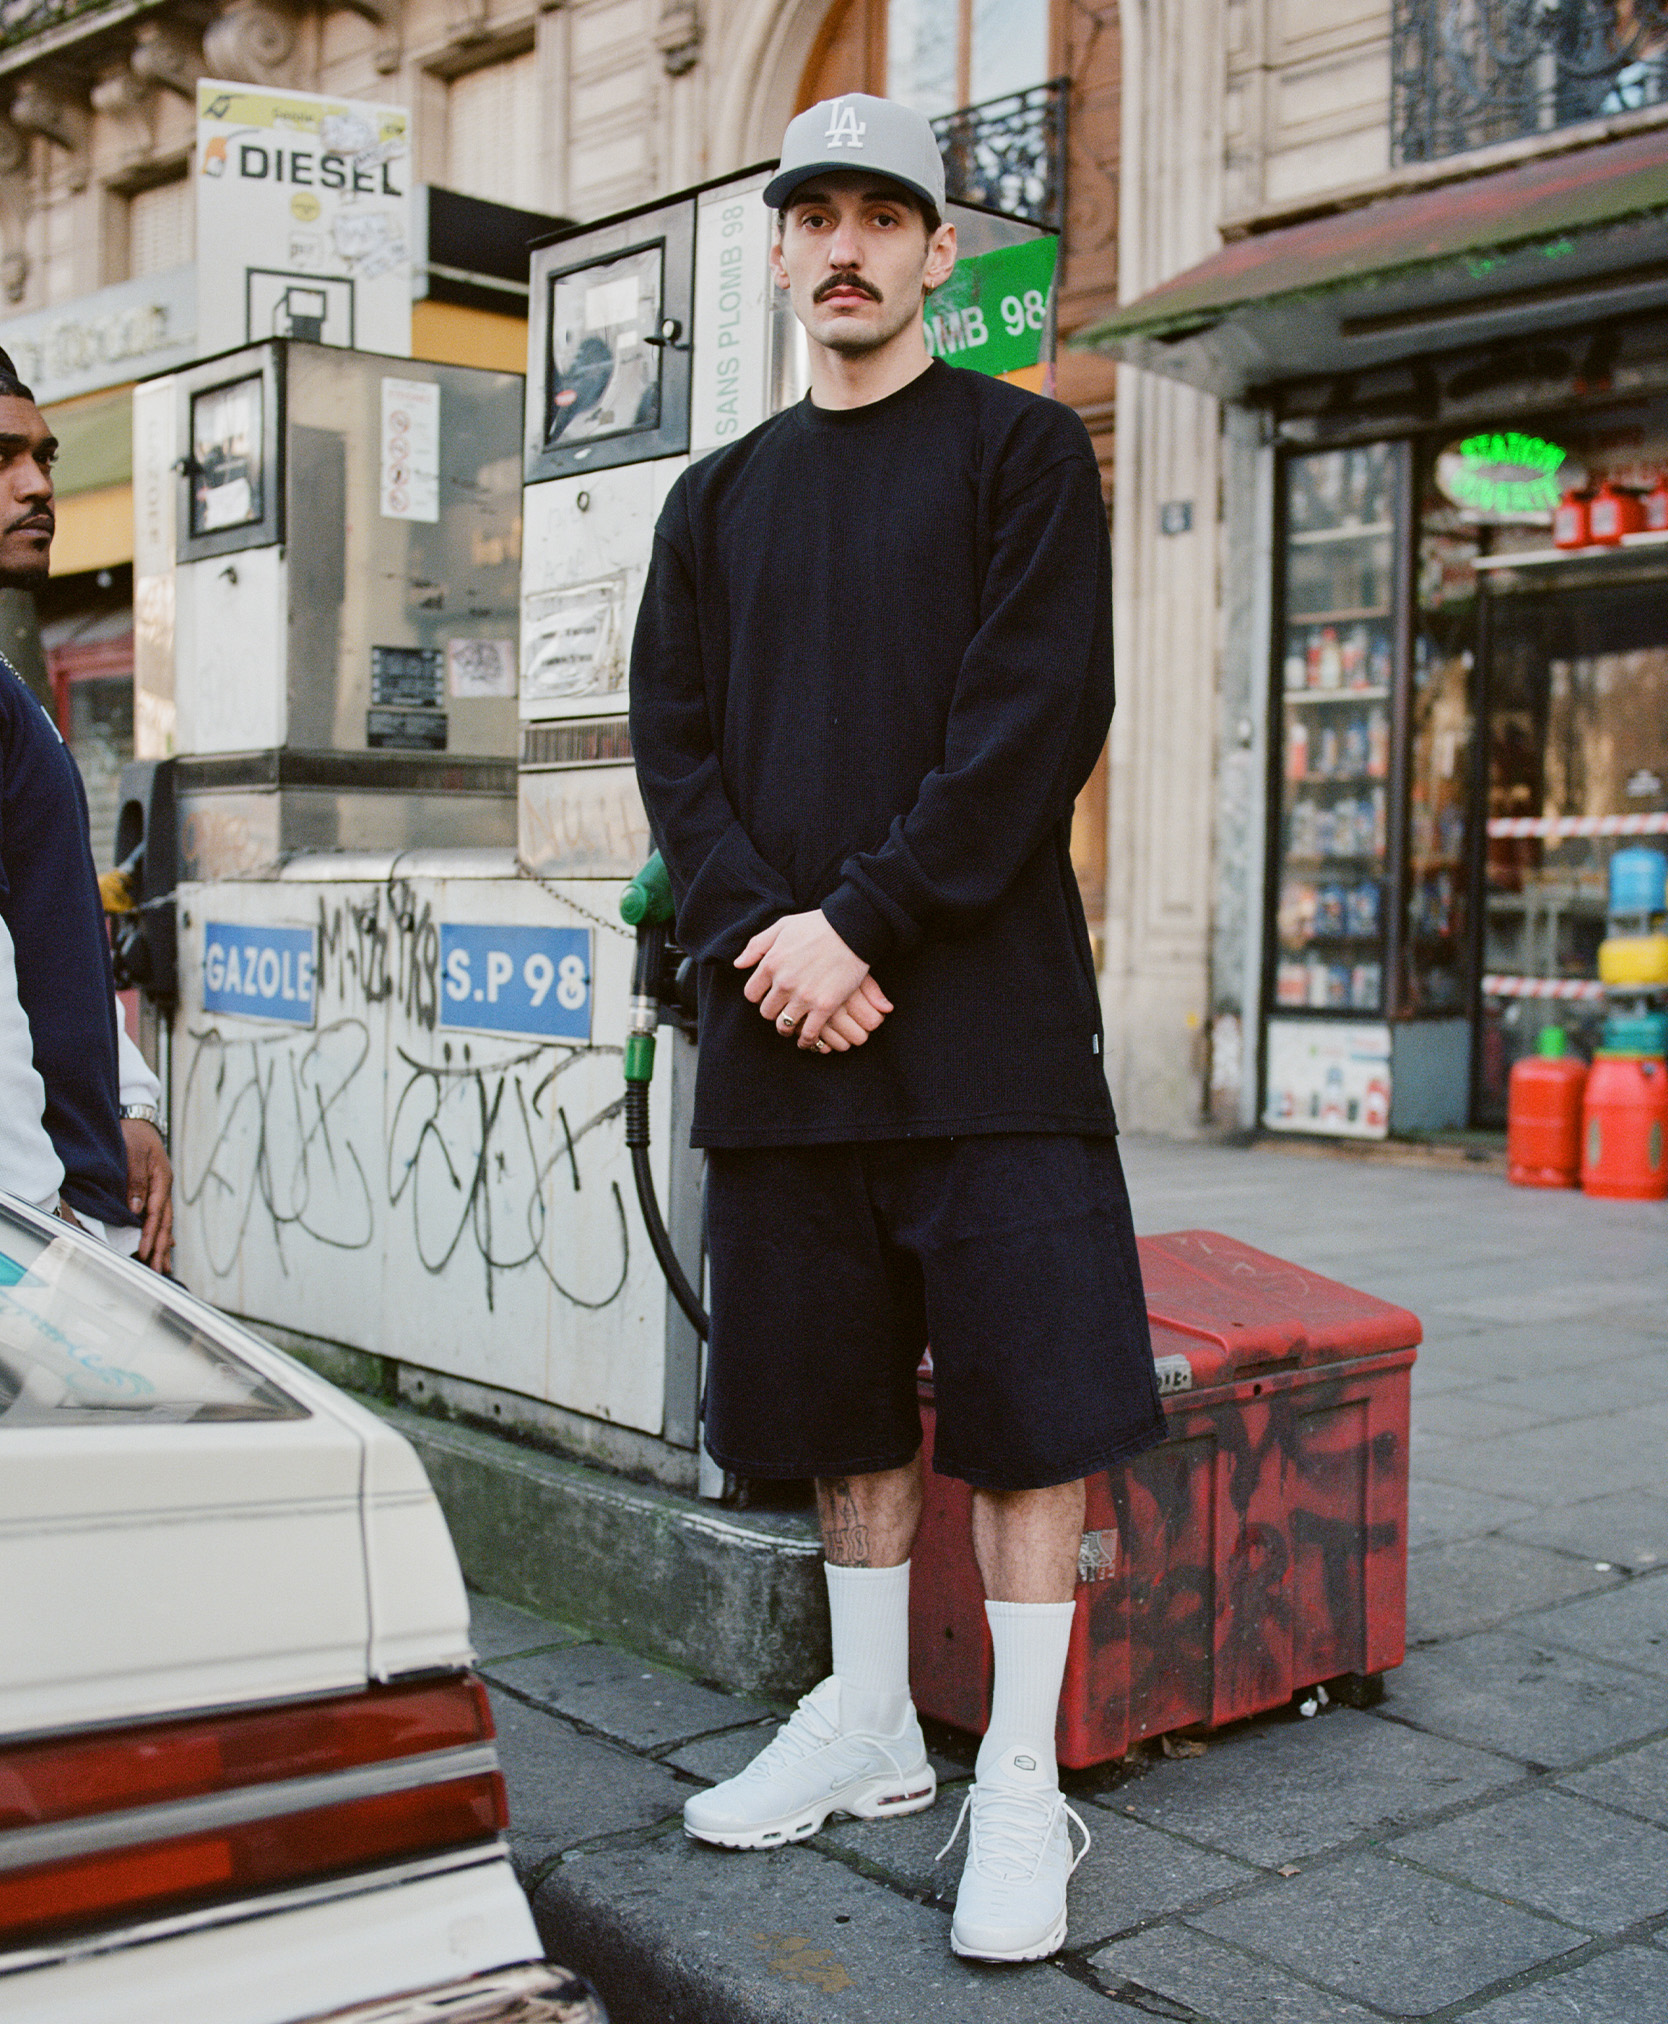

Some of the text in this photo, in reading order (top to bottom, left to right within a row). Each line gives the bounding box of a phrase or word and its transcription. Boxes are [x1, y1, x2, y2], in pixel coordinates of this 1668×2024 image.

[824, 99, 866, 149] LA
[240, 144, 402, 197] DIESEL
[715, 204, 745, 436] SANS PLOMB 98
[1000, 289, 1047, 337] 98
[206, 942, 314, 1002] GAZOLE
[446, 947, 588, 1010] S.P 98
